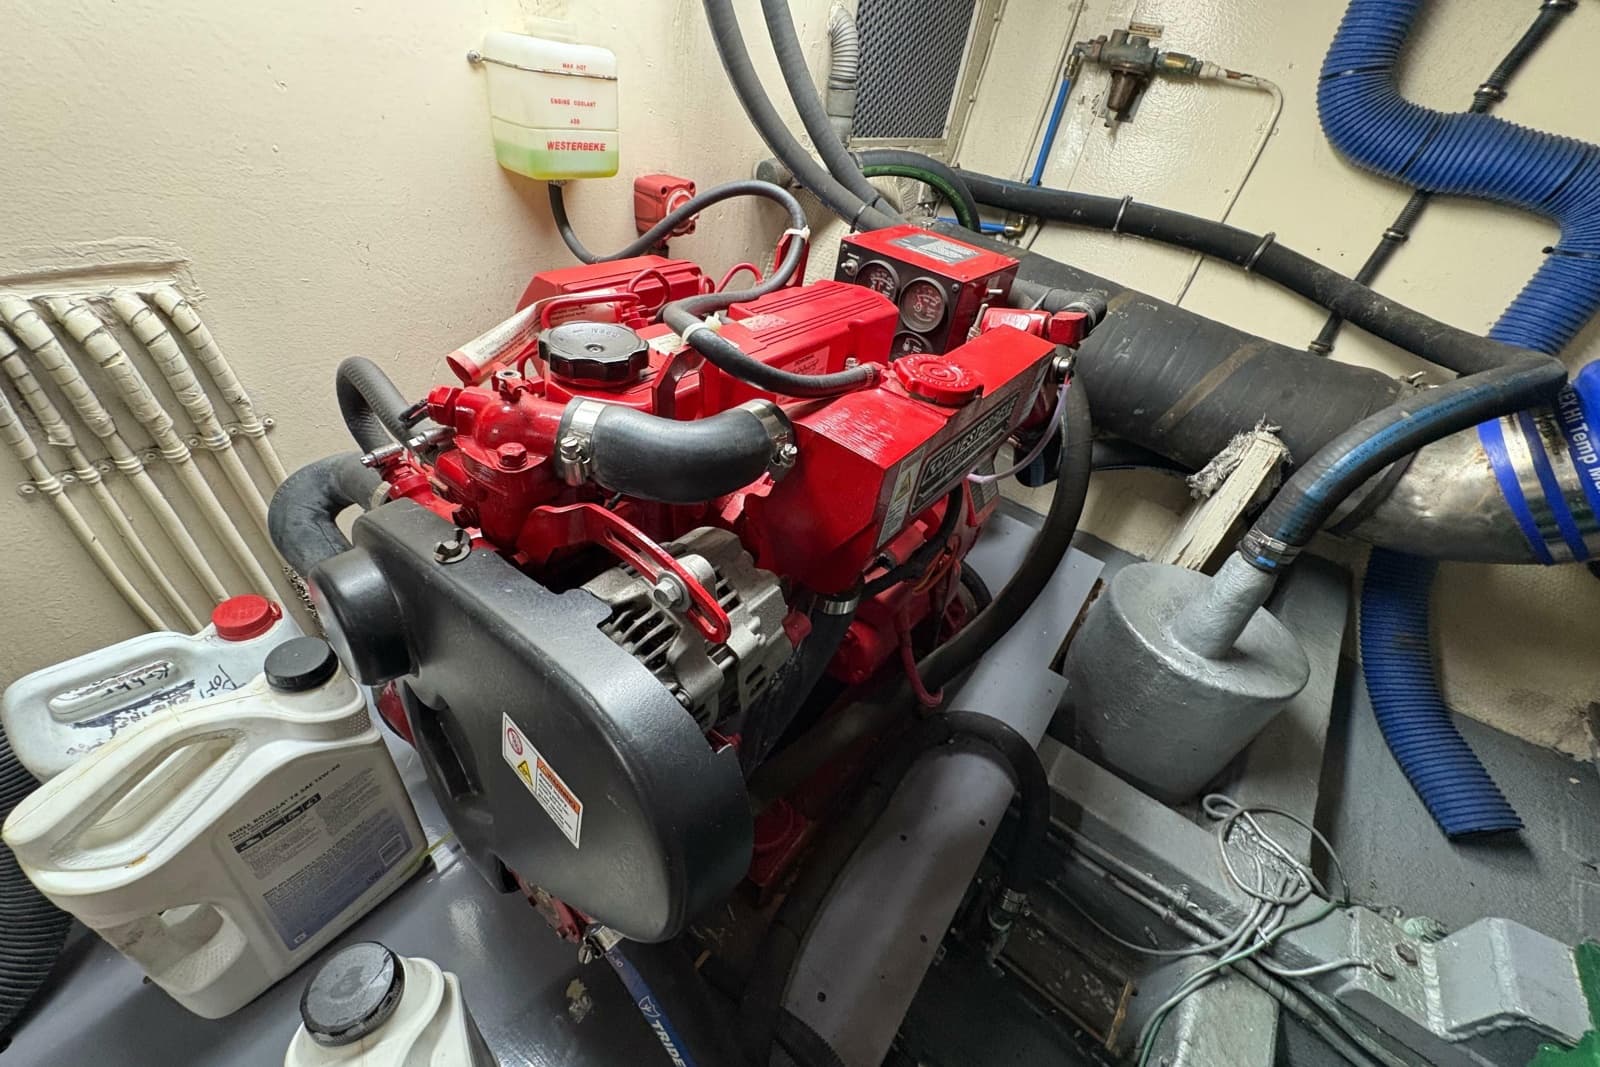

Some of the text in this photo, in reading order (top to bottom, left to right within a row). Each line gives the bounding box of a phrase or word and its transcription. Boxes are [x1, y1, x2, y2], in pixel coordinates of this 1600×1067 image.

[550, 97, 571, 105] ENGINE
[547, 141, 606, 151] WESTERBEKE
[1569, 422, 1599, 464] Temp
[228, 822, 251, 838] SHELL
